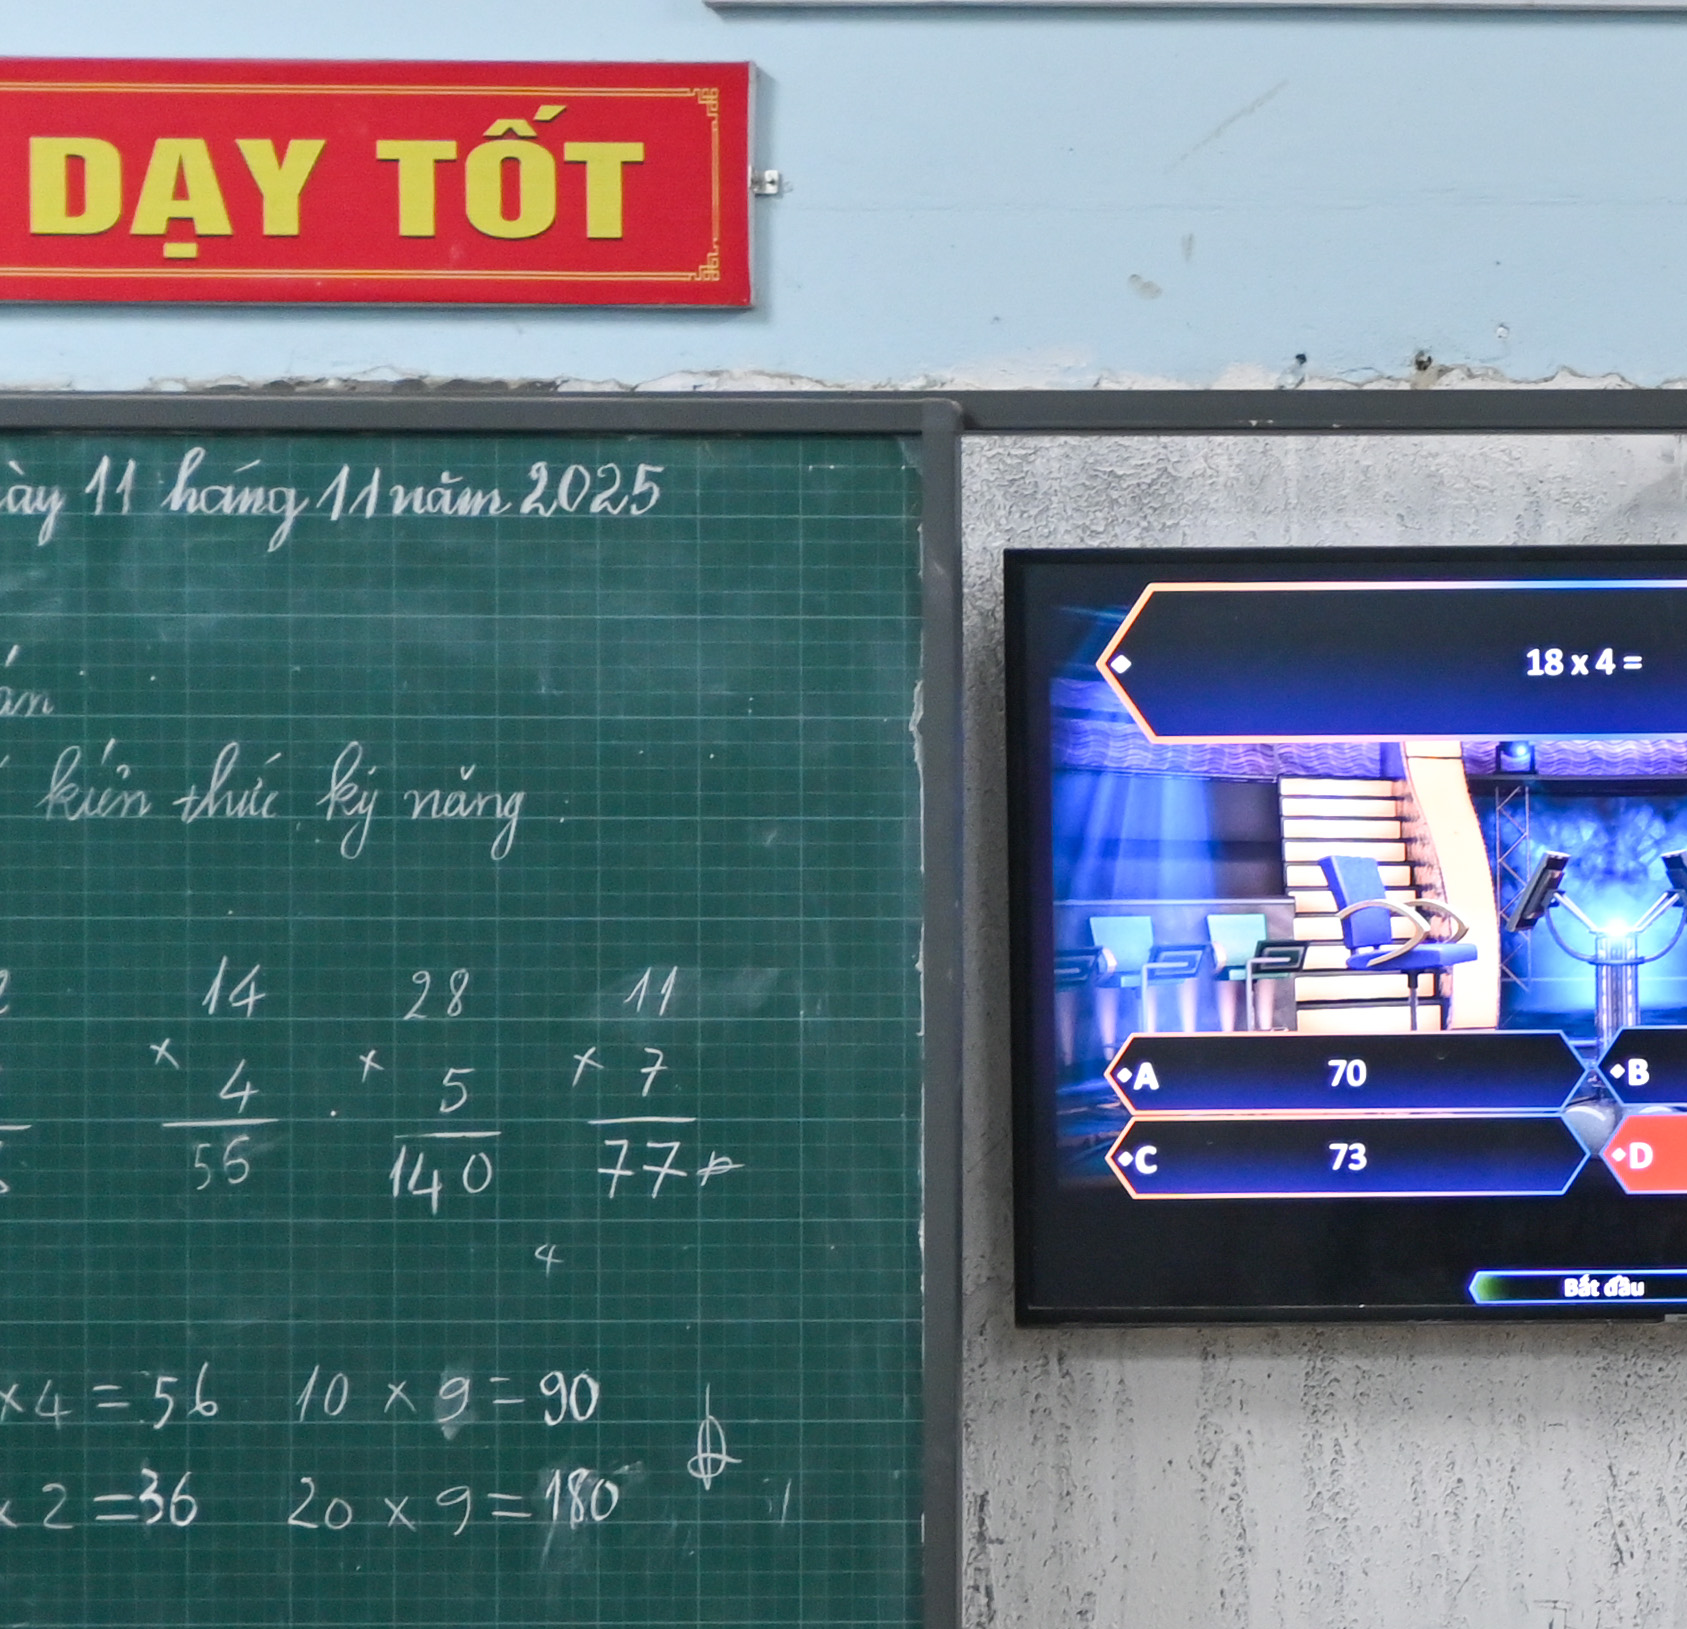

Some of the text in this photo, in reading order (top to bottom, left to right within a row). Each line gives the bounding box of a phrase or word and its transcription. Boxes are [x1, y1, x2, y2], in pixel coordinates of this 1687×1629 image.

[29, 104, 645, 258] DẠY TỐT
[84, 455, 137, 515] 11
[316, 463, 381, 521] 11
[389, 471, 513, 517] năm
[519, 462, 665, 517] 2025
[1526, 647, 1643, 676] 18 x 4 =
[202, 955, 266, 1018] 14
[403, 968, 469, 1020] 28
[624, 966, 678, 1016] 11
[219, 1059, 259, 1113] 4
[440, 1068, 475, 1112] 5
[641, 1047, 667, 1096] 7
[1134, 1060, 1367, 1090] A 70
[1628, 1058, 1650, 1085] B
[390, 1145, 492, 1215] 140
[597, 1139, 688, 1199] 77
[1136, 1145, 1368, 1174] C 73
[1629, 1142, 1653, 1168] D
[153, 1361, 218, 1430] 56
[296, 1364, 349, 1422] 10
[438, 1376, 470, 1423] 9
[539, 1369, 600, 1426] 90
[138, 1468, 198, 1527] 36
[288, 1476, 353, 1530] 20
[436, 1486, 471, 1536] 9
[545, 1467, 620, 1529] 180
